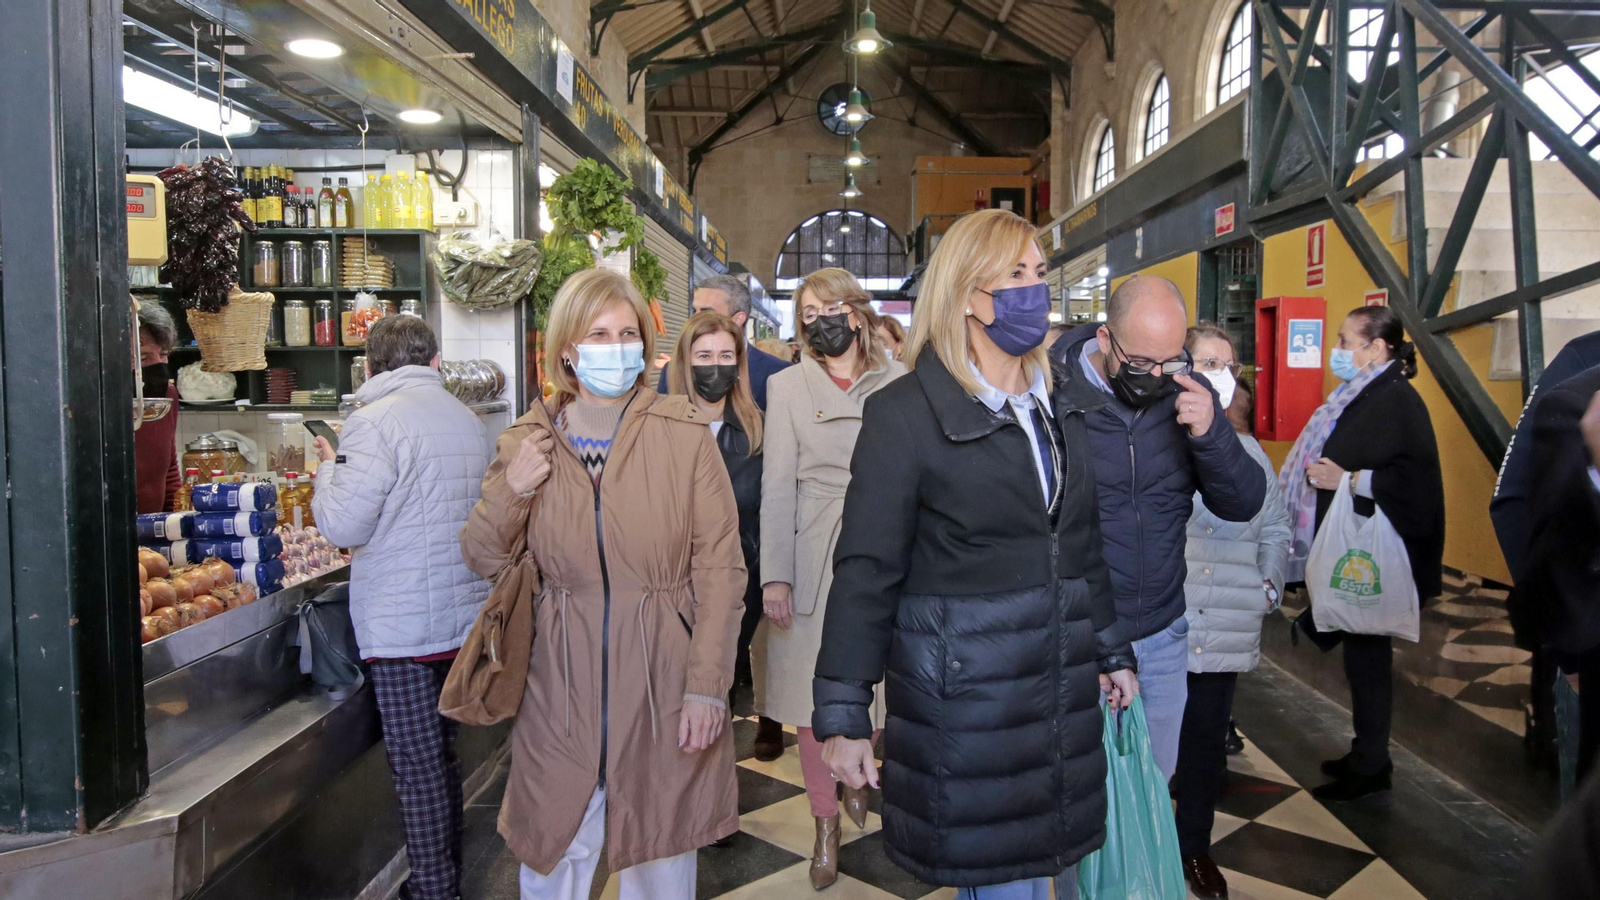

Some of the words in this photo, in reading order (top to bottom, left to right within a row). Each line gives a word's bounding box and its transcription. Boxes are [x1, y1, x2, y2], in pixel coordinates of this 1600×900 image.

[456, 0, 515, 55] ALLEGO
[576, 66, 604, 117] FRUTAS
[604, 101, 611, 124] Y
